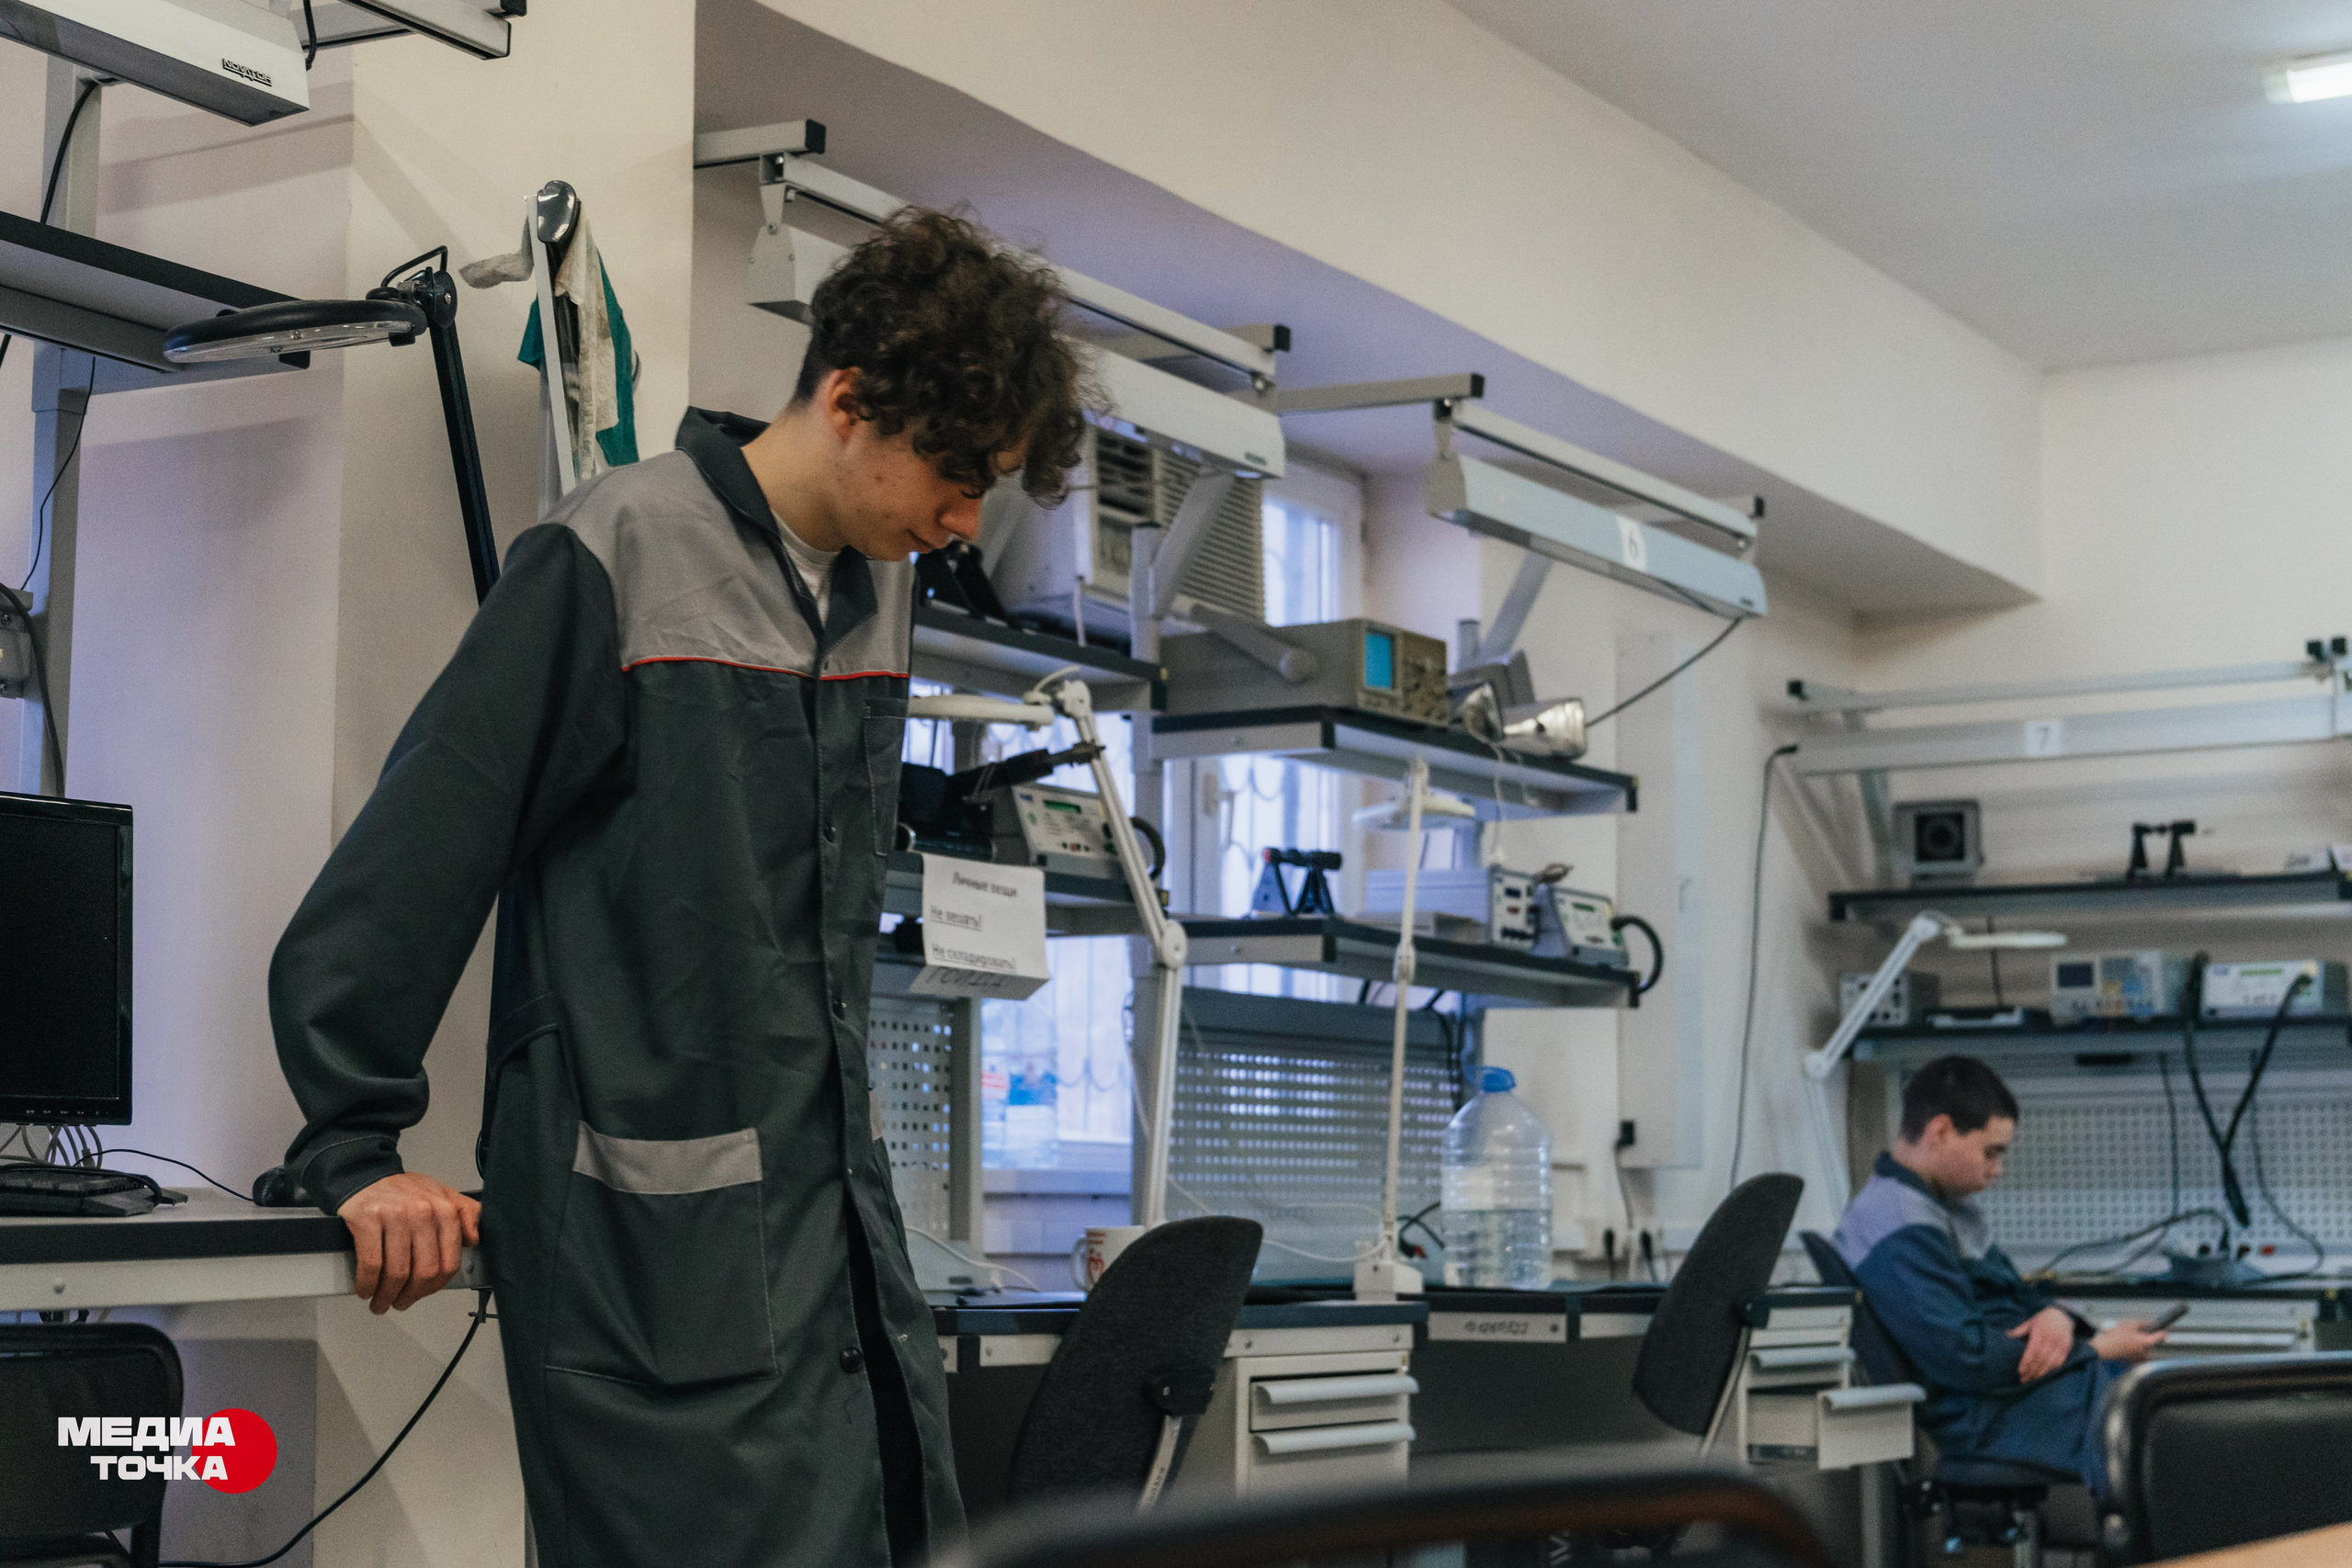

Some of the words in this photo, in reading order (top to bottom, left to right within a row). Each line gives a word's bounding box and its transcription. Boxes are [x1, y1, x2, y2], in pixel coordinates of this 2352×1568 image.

[1628, 530, 1639, 560] 6
[2038, 726, 2050, 750] 7
[952, 872, 988, 892] Личные
[989, 883, 1018, 898] вещи
[930, 904, 943, 920] Не
[945, 909, 982, 928] вешать!
[932, 942, 945, 958] Не
[947, 948, 1016, 970] складировать!
